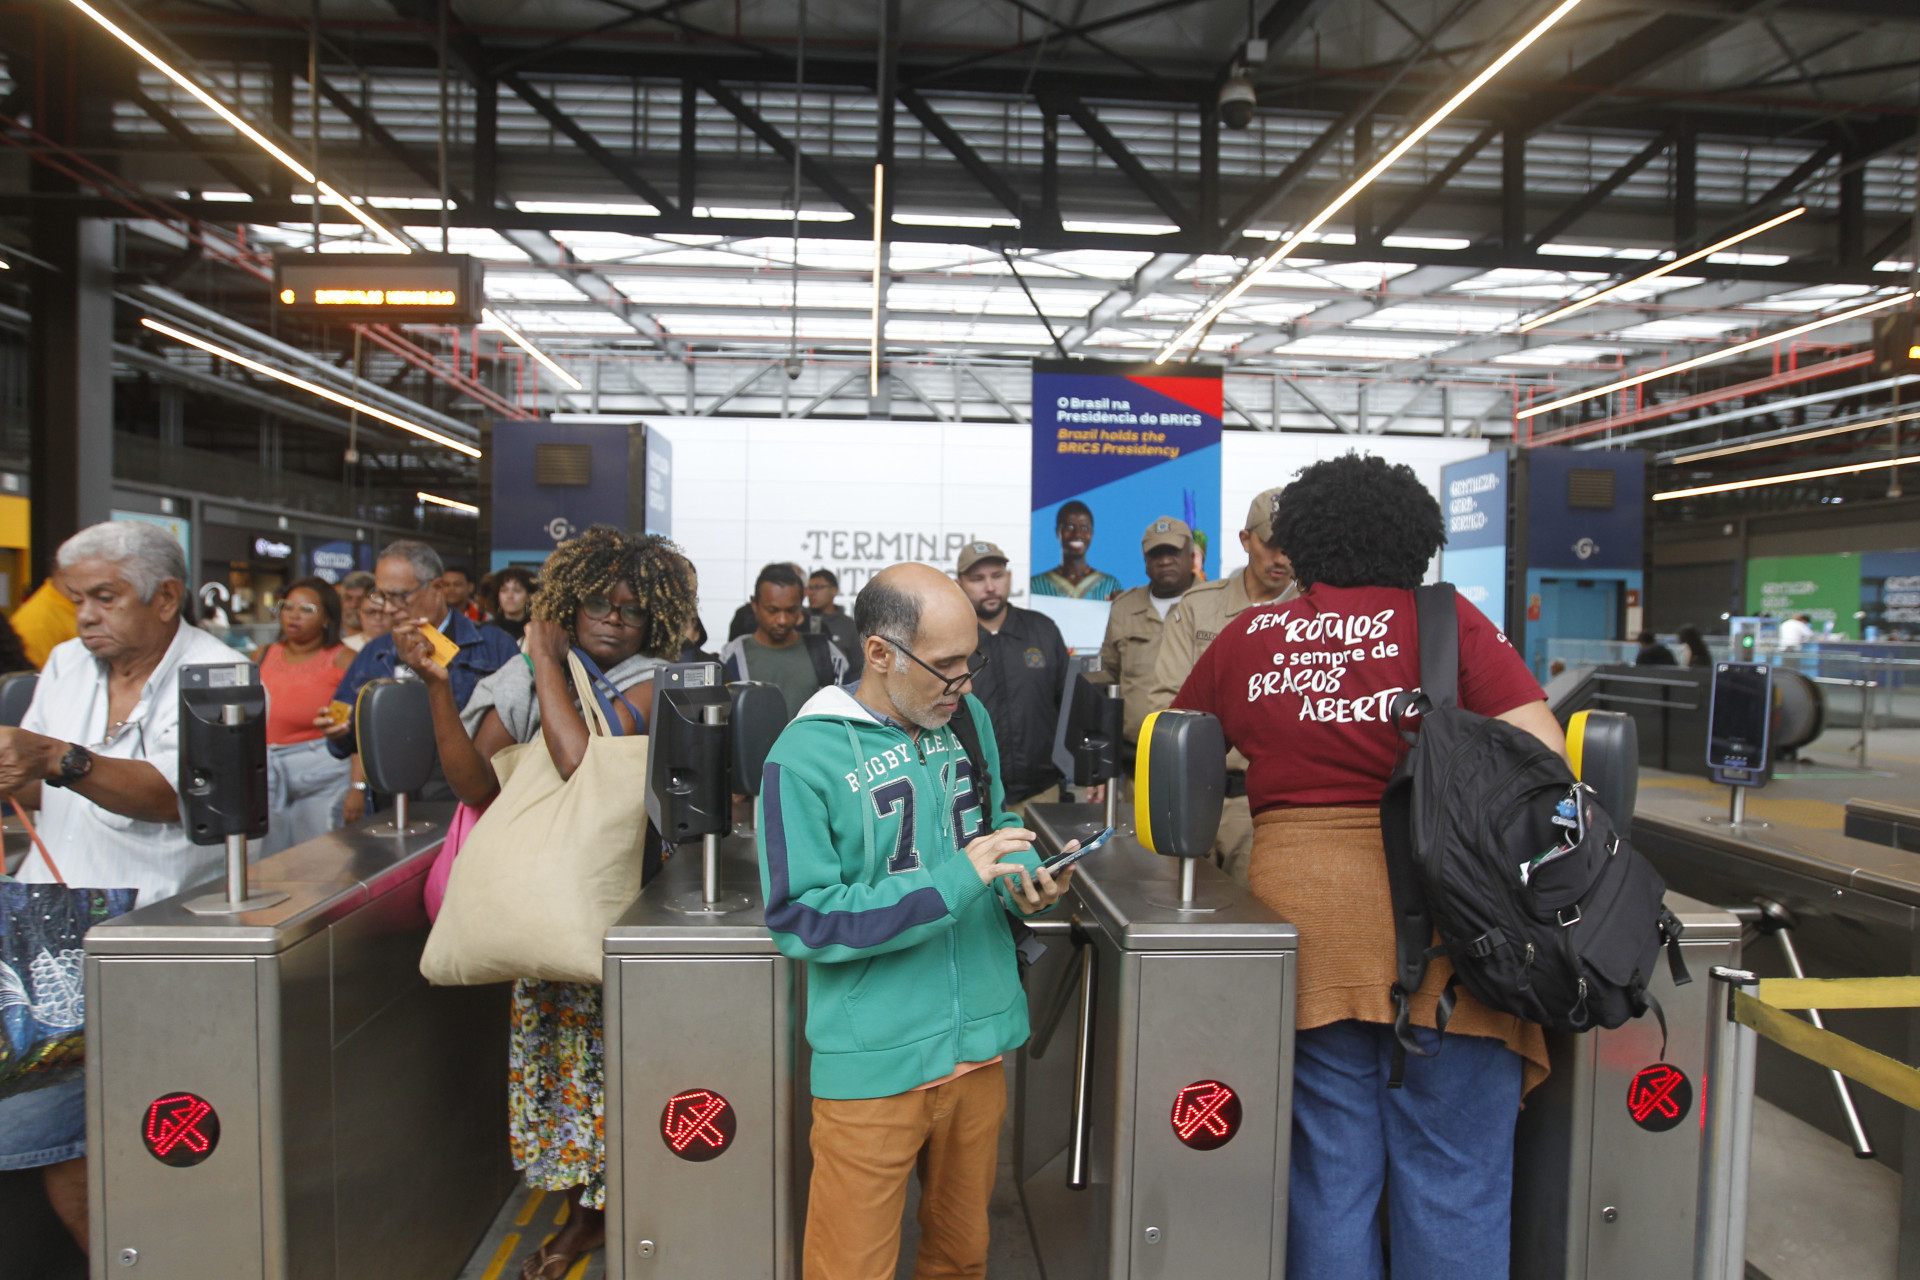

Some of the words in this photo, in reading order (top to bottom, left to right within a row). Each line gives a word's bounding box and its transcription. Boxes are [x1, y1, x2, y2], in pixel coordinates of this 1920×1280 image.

[1057, 397, 1069, 409] O
[1071, 397, 1109, 410] Brasil
[1112, 400, 1130, 410] na
[1057, 410, 1137, 424] Presidência
[1139, 412, 1157, 425] do
[1160, 413, 1202, 427] BRICS
[1057, 428, 1098, 440] Brazil
[1100, 429, 1138, 442] holds
[1141, 430, 1165, 443] the
[1057, 442, 1100, 454] BRICS
[1102, 443, 1180, 459] Presidency
[1246, 610, 1291, 635] SEM
[1285, 609, 1395, 645] RÓTULOS
[1272, 652, 1284, 665] e
[1289, 648, 1365, 668] sempre
[1371, 641, 1399, 659] de
[1247, 667, 1346, 702] BRAÇOS
[923, 733, 964, 756] LEG
